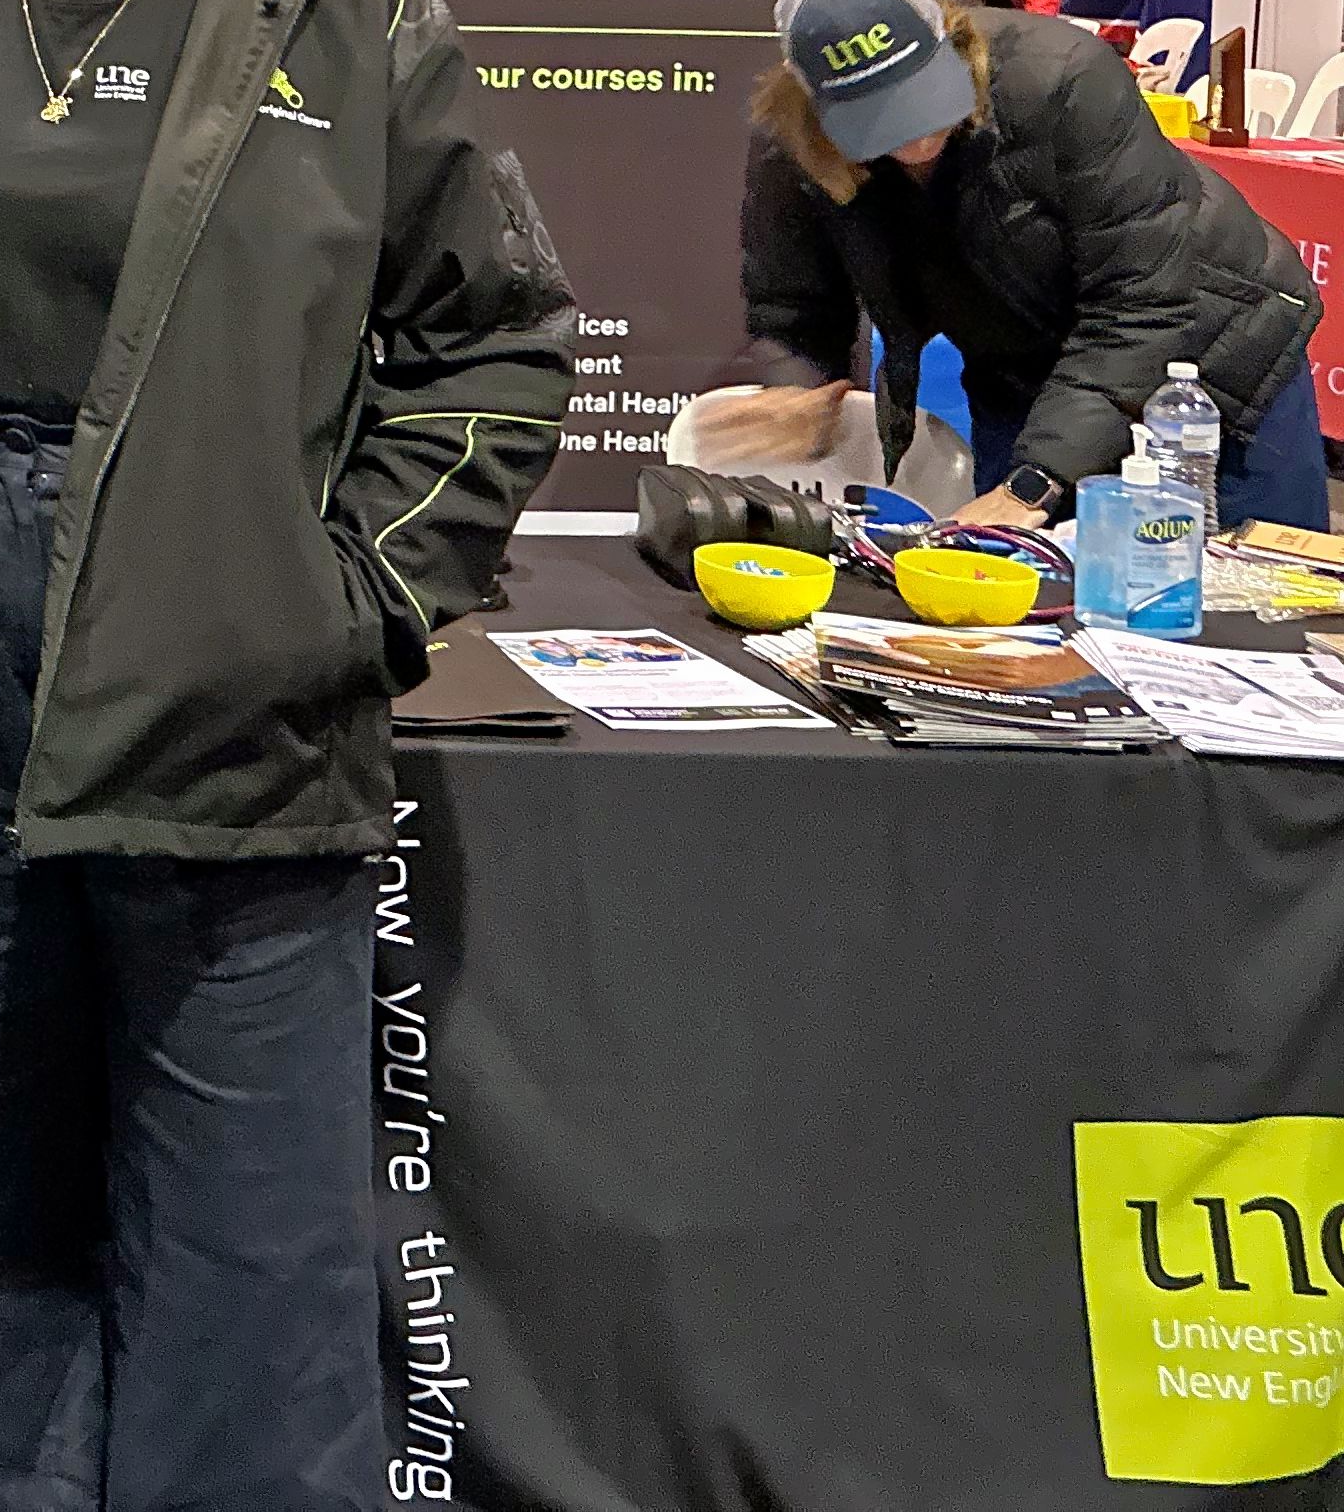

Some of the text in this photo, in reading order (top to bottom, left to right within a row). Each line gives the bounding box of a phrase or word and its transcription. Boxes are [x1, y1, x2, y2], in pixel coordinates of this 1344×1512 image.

[820, 20, 897, 72] une
[96, 66, 150, 86] une
[532, 63, 715, 93] courses in:
[622, 392, 697, 414] Healt
[604, 430, 668, 453] Healt
[373, 983, 469, 1501] you're thinking
[1158, 1366, 1249, 1400] New
